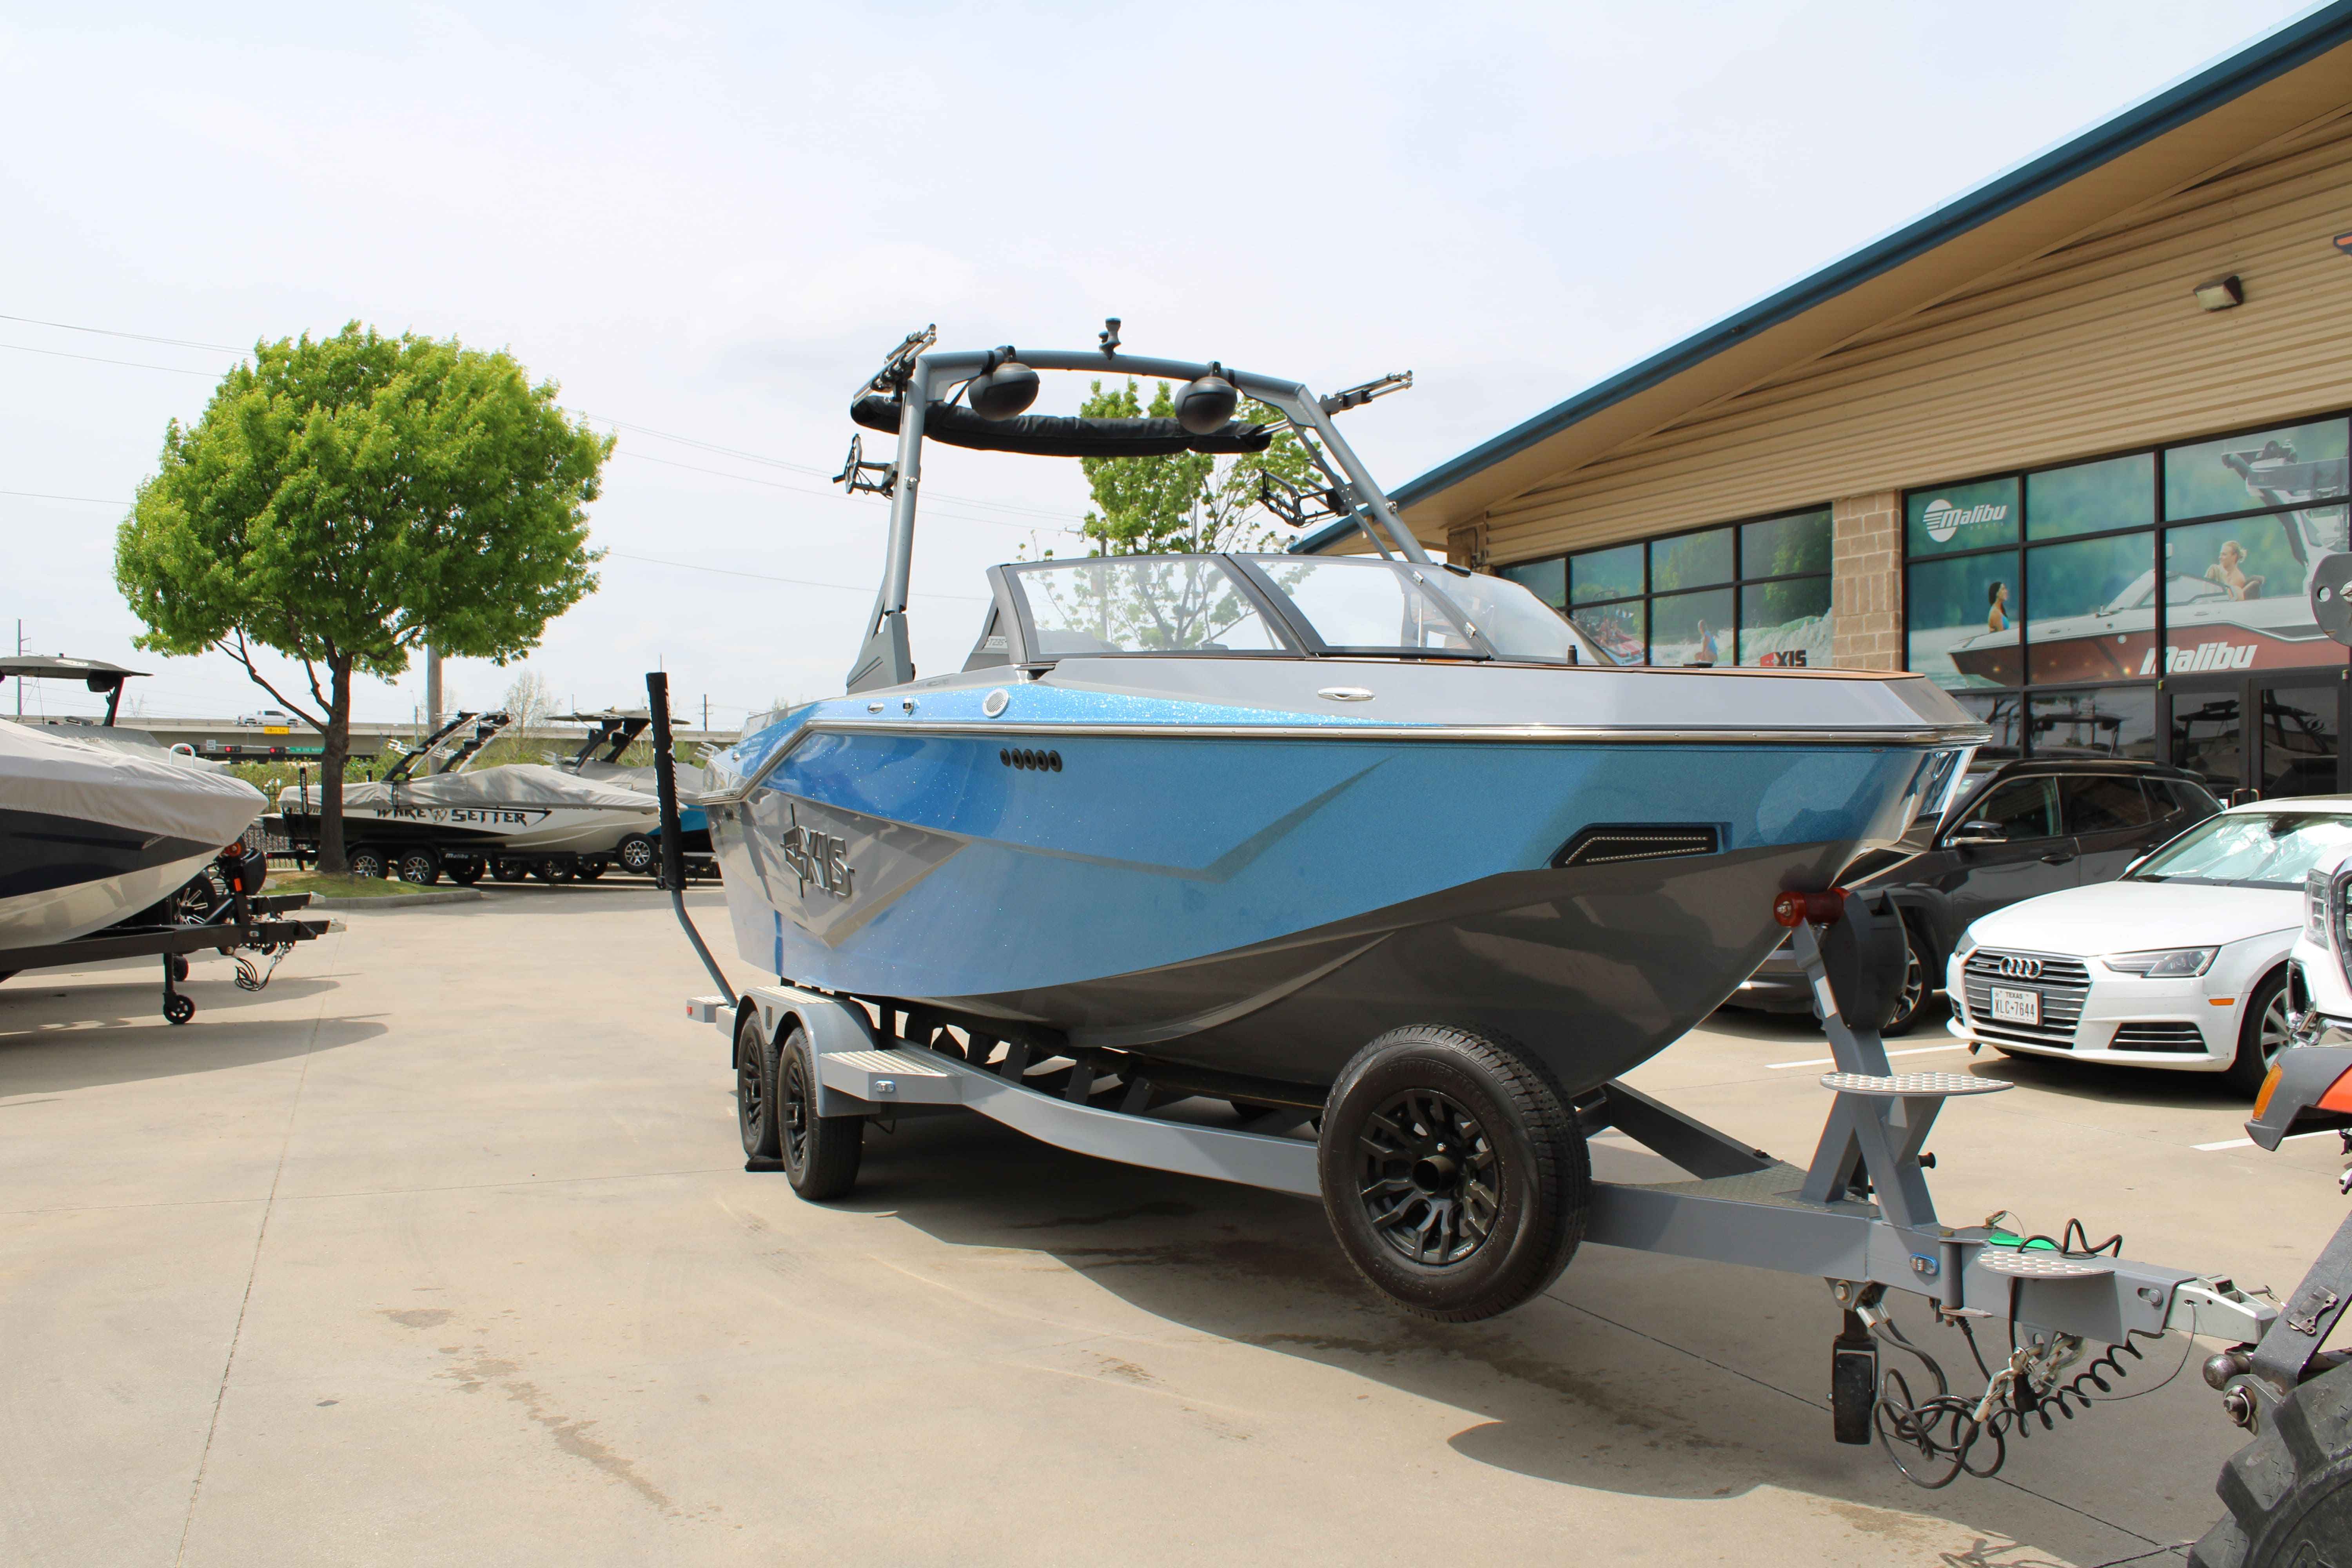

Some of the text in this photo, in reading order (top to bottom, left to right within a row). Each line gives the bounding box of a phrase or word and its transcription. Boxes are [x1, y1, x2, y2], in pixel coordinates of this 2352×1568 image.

[1939, 504, 2007, 528] Malibu
[1759, 650, 1806, 667] AXIS
[782, 825, 853, 897] AXIS
